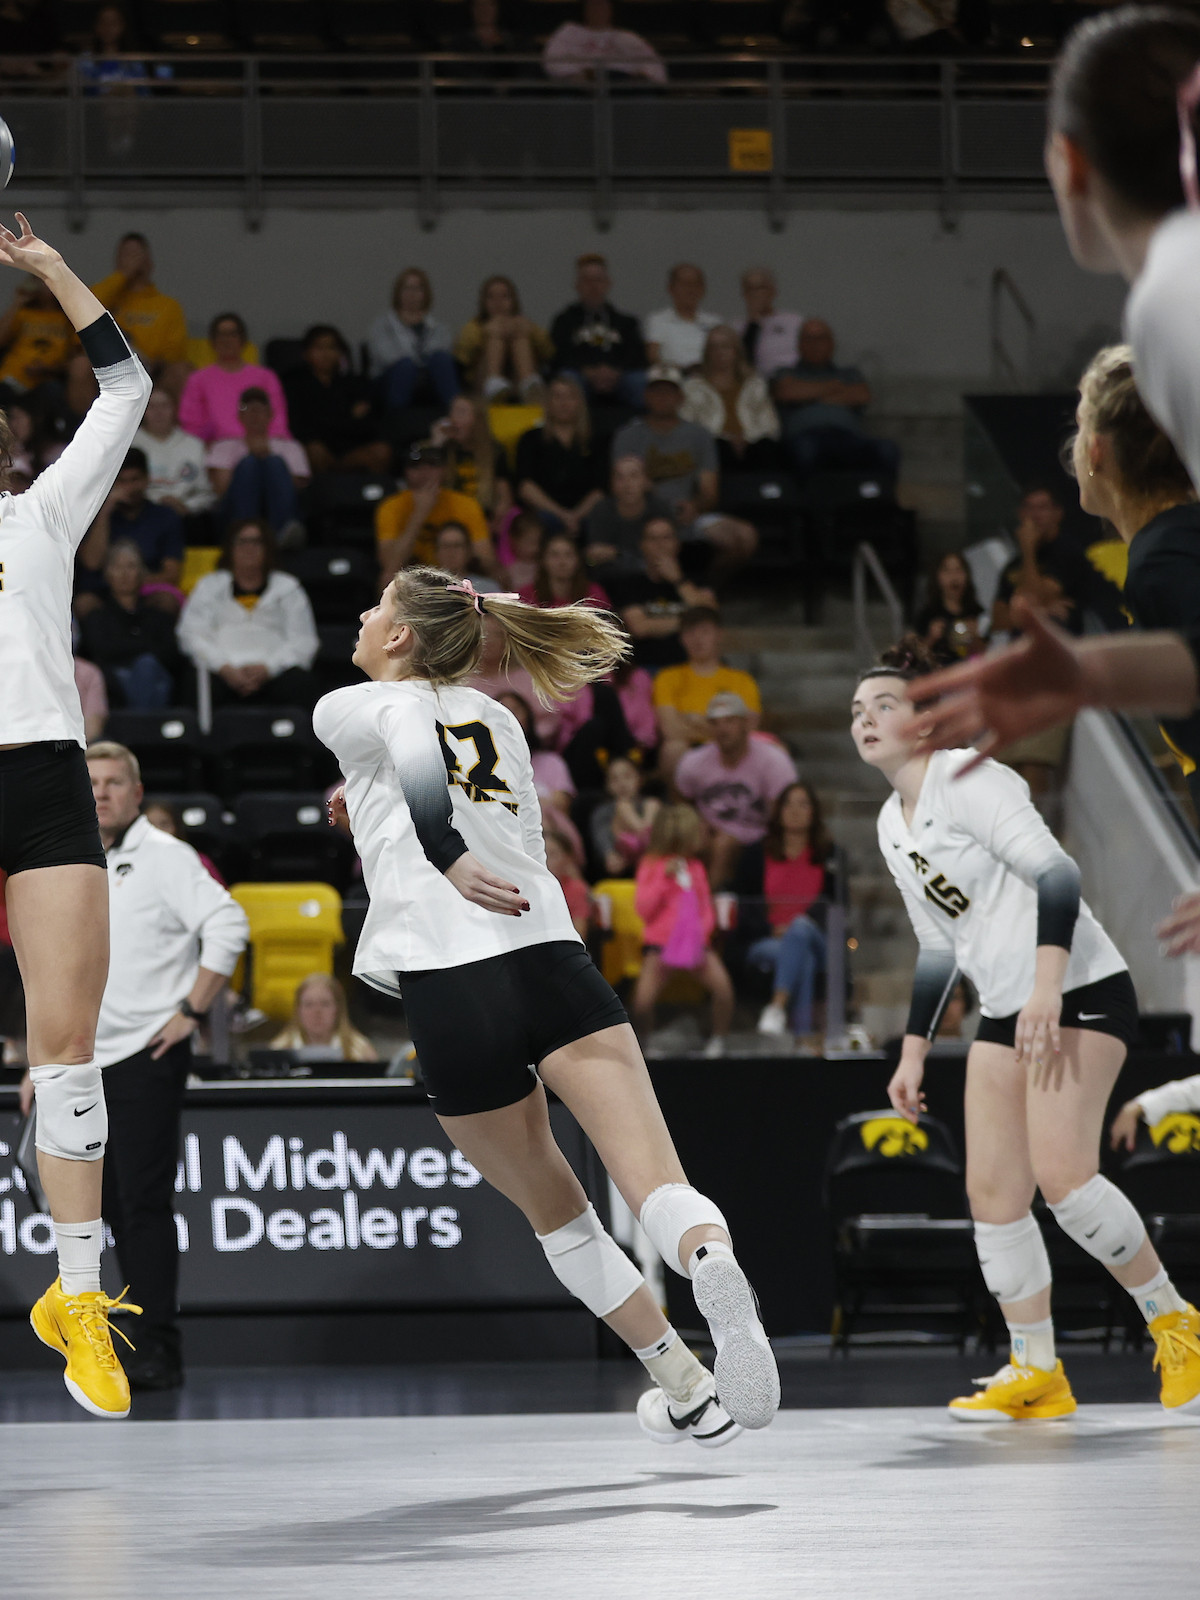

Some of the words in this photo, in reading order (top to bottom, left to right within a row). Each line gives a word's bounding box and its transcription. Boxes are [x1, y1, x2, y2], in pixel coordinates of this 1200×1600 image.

[924, 873, 970, 919] 15
[222, 1130, 483, 1191] Midwes
[210, 1189, 463, 1252] Dealers
